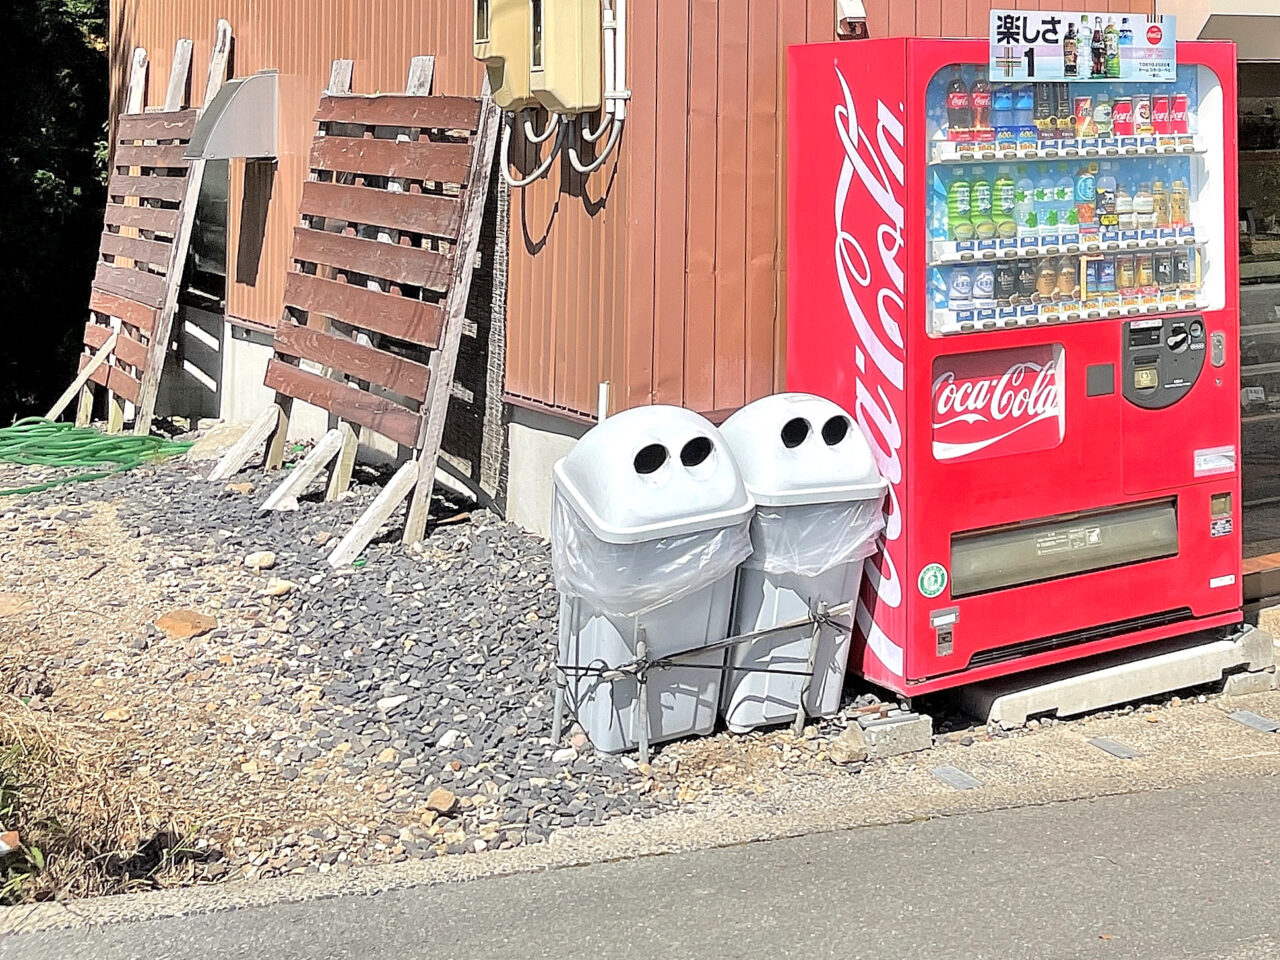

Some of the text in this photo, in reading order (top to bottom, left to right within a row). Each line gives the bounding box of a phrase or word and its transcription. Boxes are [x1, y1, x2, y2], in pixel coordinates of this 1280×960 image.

[997, 14, 1062, 45] 楽しさ
[932, 360, 1060, 428] Coca-Cola
